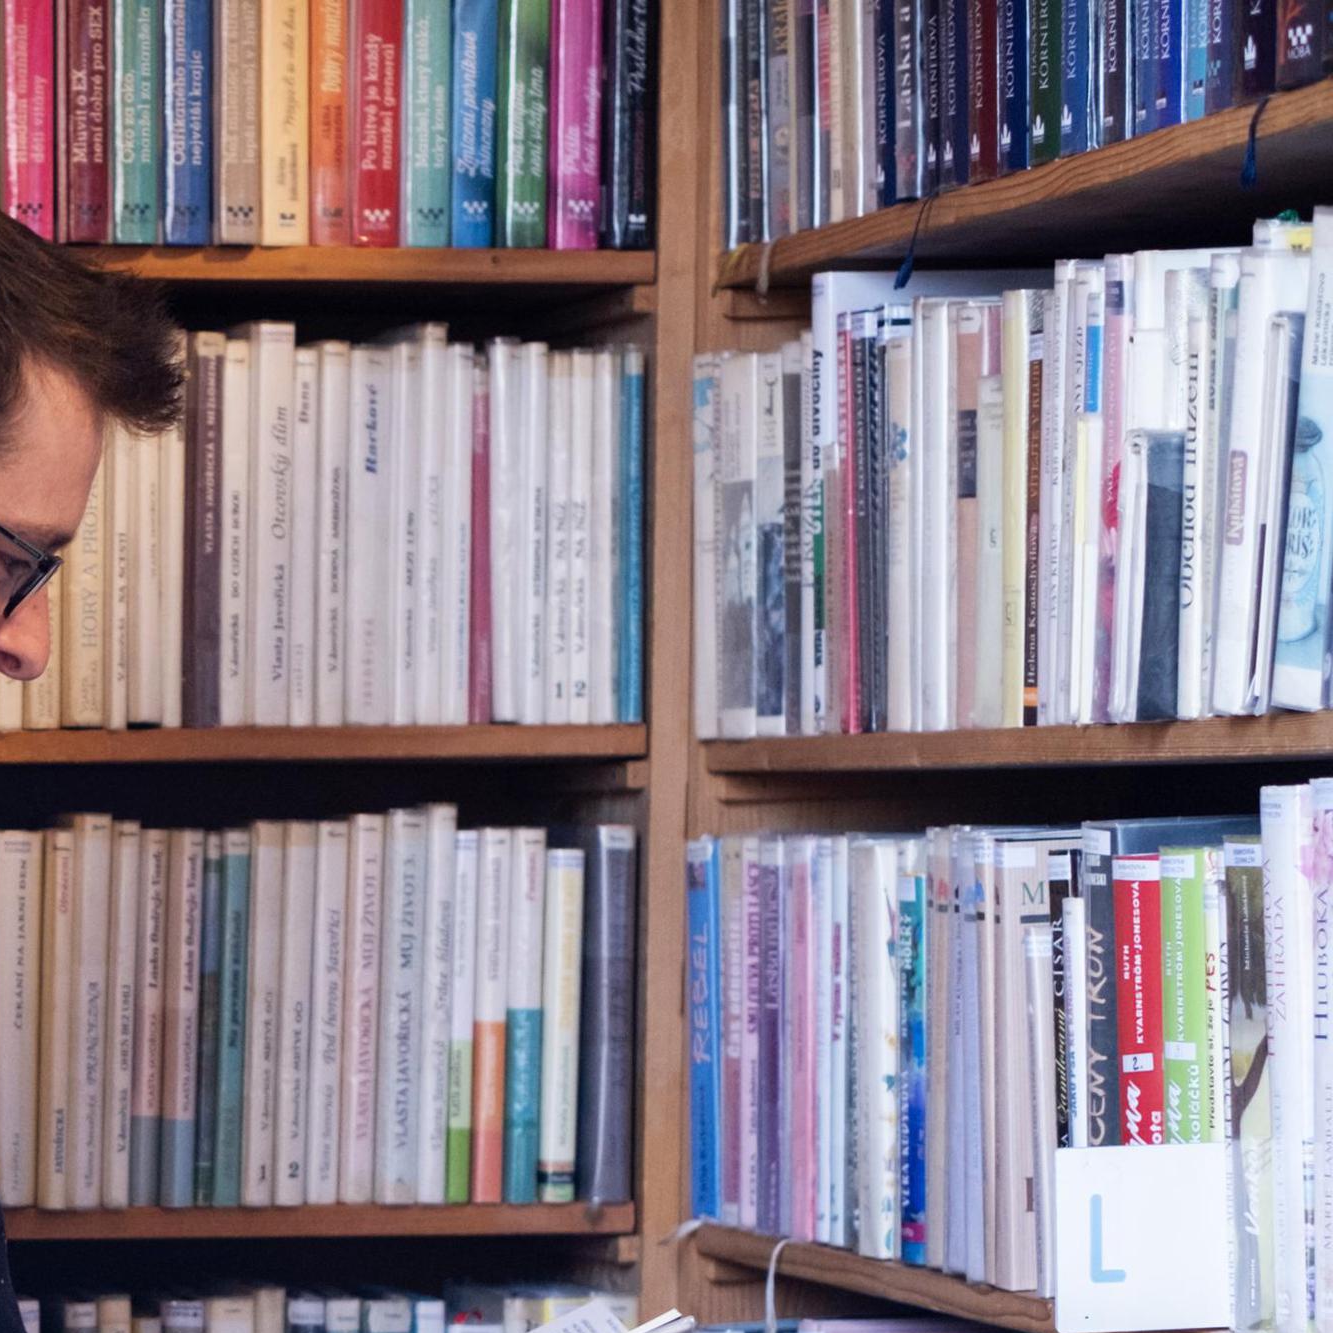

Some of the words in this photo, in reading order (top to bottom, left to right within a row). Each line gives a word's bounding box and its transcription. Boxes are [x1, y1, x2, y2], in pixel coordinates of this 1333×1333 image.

[89, 5, 103, 39] SEX
[92, 43, 106, 69] pro
[362, 33, 381, 82] každý
[89, 75, 102, 121] dobré
[138, 105, 151, 161] manžel
[362, 148, 376, 170] Po
[380, 111, 394, 169] manžel
[270, 406, 288, 446] dům
[269, 454, 291, 540] Otcovský
[270, 563, 286, 630] Javořická
[270, 636, 284, 681] Vlasta
[1027, 633, 1037, 685] Helena
[17, 859, 28, 891] DEN
[396, 871, 416, 929] ŽIVOT
[16, 946, 26, 967] NA
[394, 934, 415, 969] MŮJ
[1122, 944, 1131, 980] RUTH
[1273, 896, 1286, 1022] ZAHRADA
[691, 922, 712, 1064] REBEL
[394, 990, 414, 1083] JAVOŘICKÁ
[1051, 1008, 1069, 1123] Zamilovaný
[395, 1087, 411, 1149] VLASTA
[1089, 1193, 1127, 1284] L
